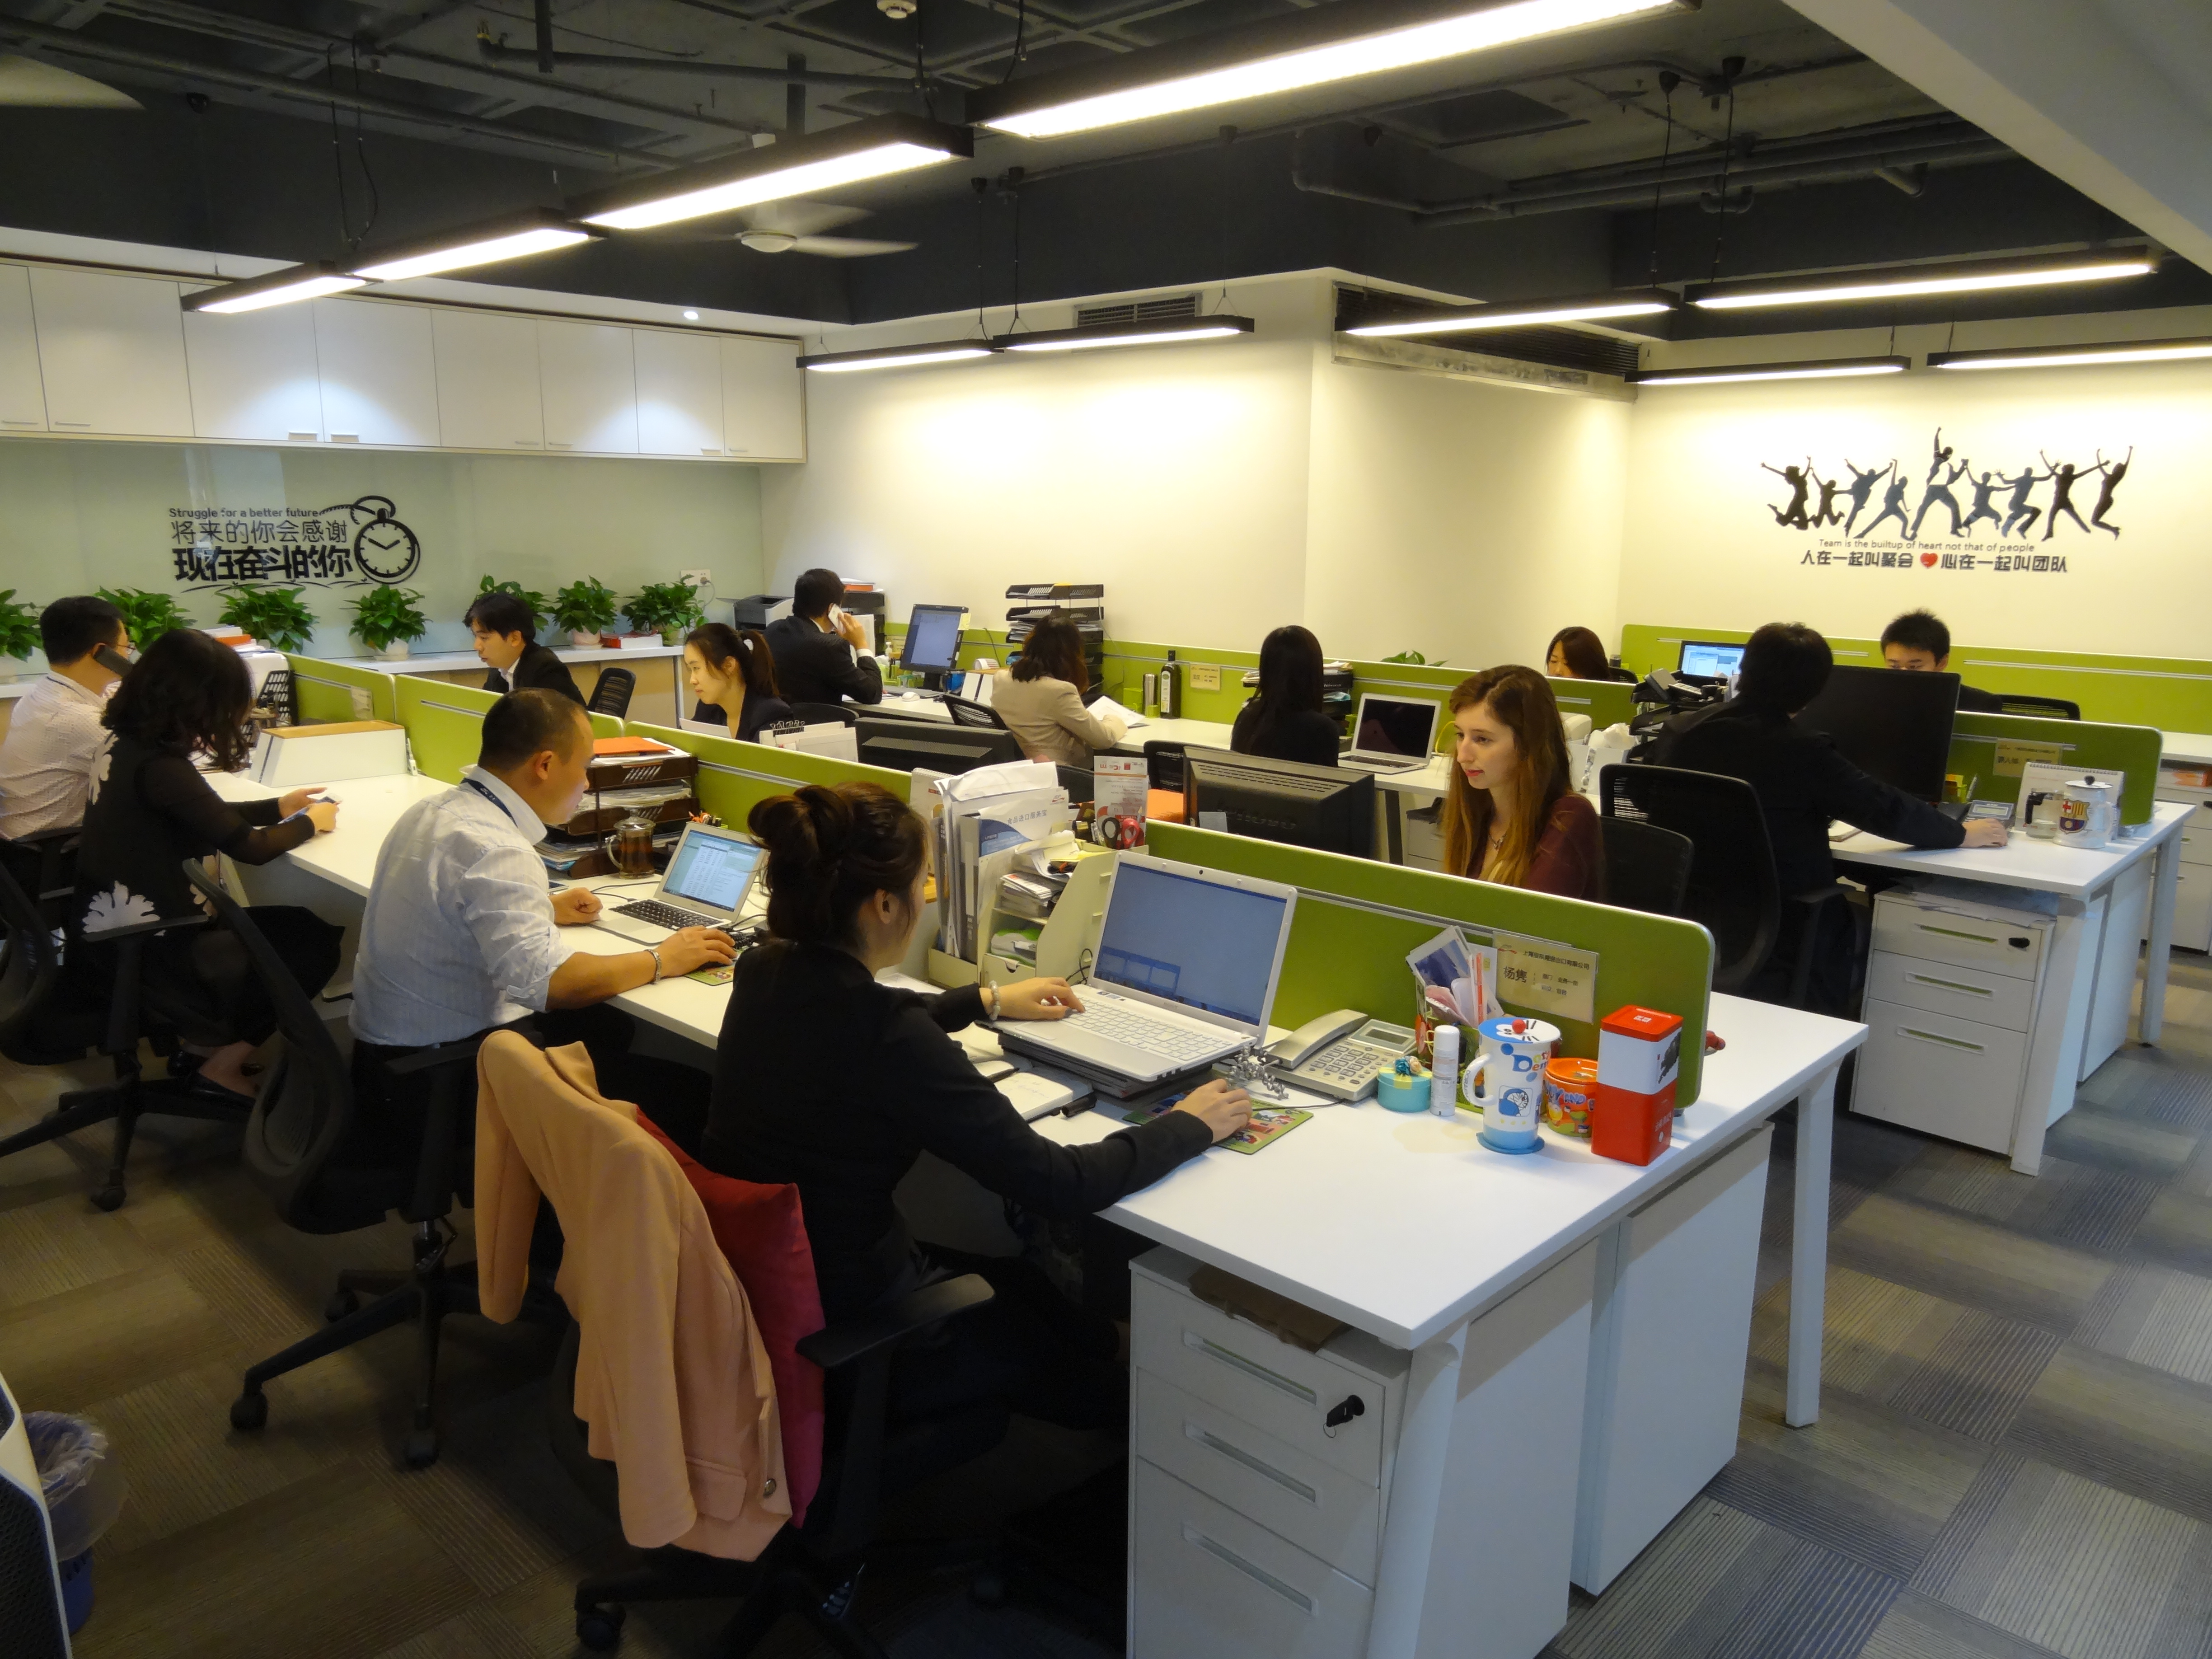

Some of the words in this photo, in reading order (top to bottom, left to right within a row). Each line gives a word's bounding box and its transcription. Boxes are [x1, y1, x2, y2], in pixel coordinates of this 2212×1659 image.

[169, 507, 218, 519] Struggle
[220, 507, 237, 517] for
[249, 507, 283, 517] better
[286, 507, 319, 517] future
[171, 519, 347, 544] 将来的你会感谢
[1819, 539, 1842, 547] Team
[1845, 539, 1851, 548] is
[1855, 539, 1869, 548] the
[1871, 539, 1903, 550] builtup
[1906, 540, 1916, 548] of
[1918, 541, 1943, 550] heart
[1945, 542, 1961, 551] not
[1964, 542, 1983, 551] that
[1986, 543, 1998, 552] of
[1999, 543, 2035, 553] people
[172, 544, 353, 581] 现在奋斗的你
[1800, 549, 1914, 569] 人在一起叫聚会
[1940, 553, 2067, 572] 心在一起叫团队
[1007, 809, 1048, 825] 食品进口服务宝
